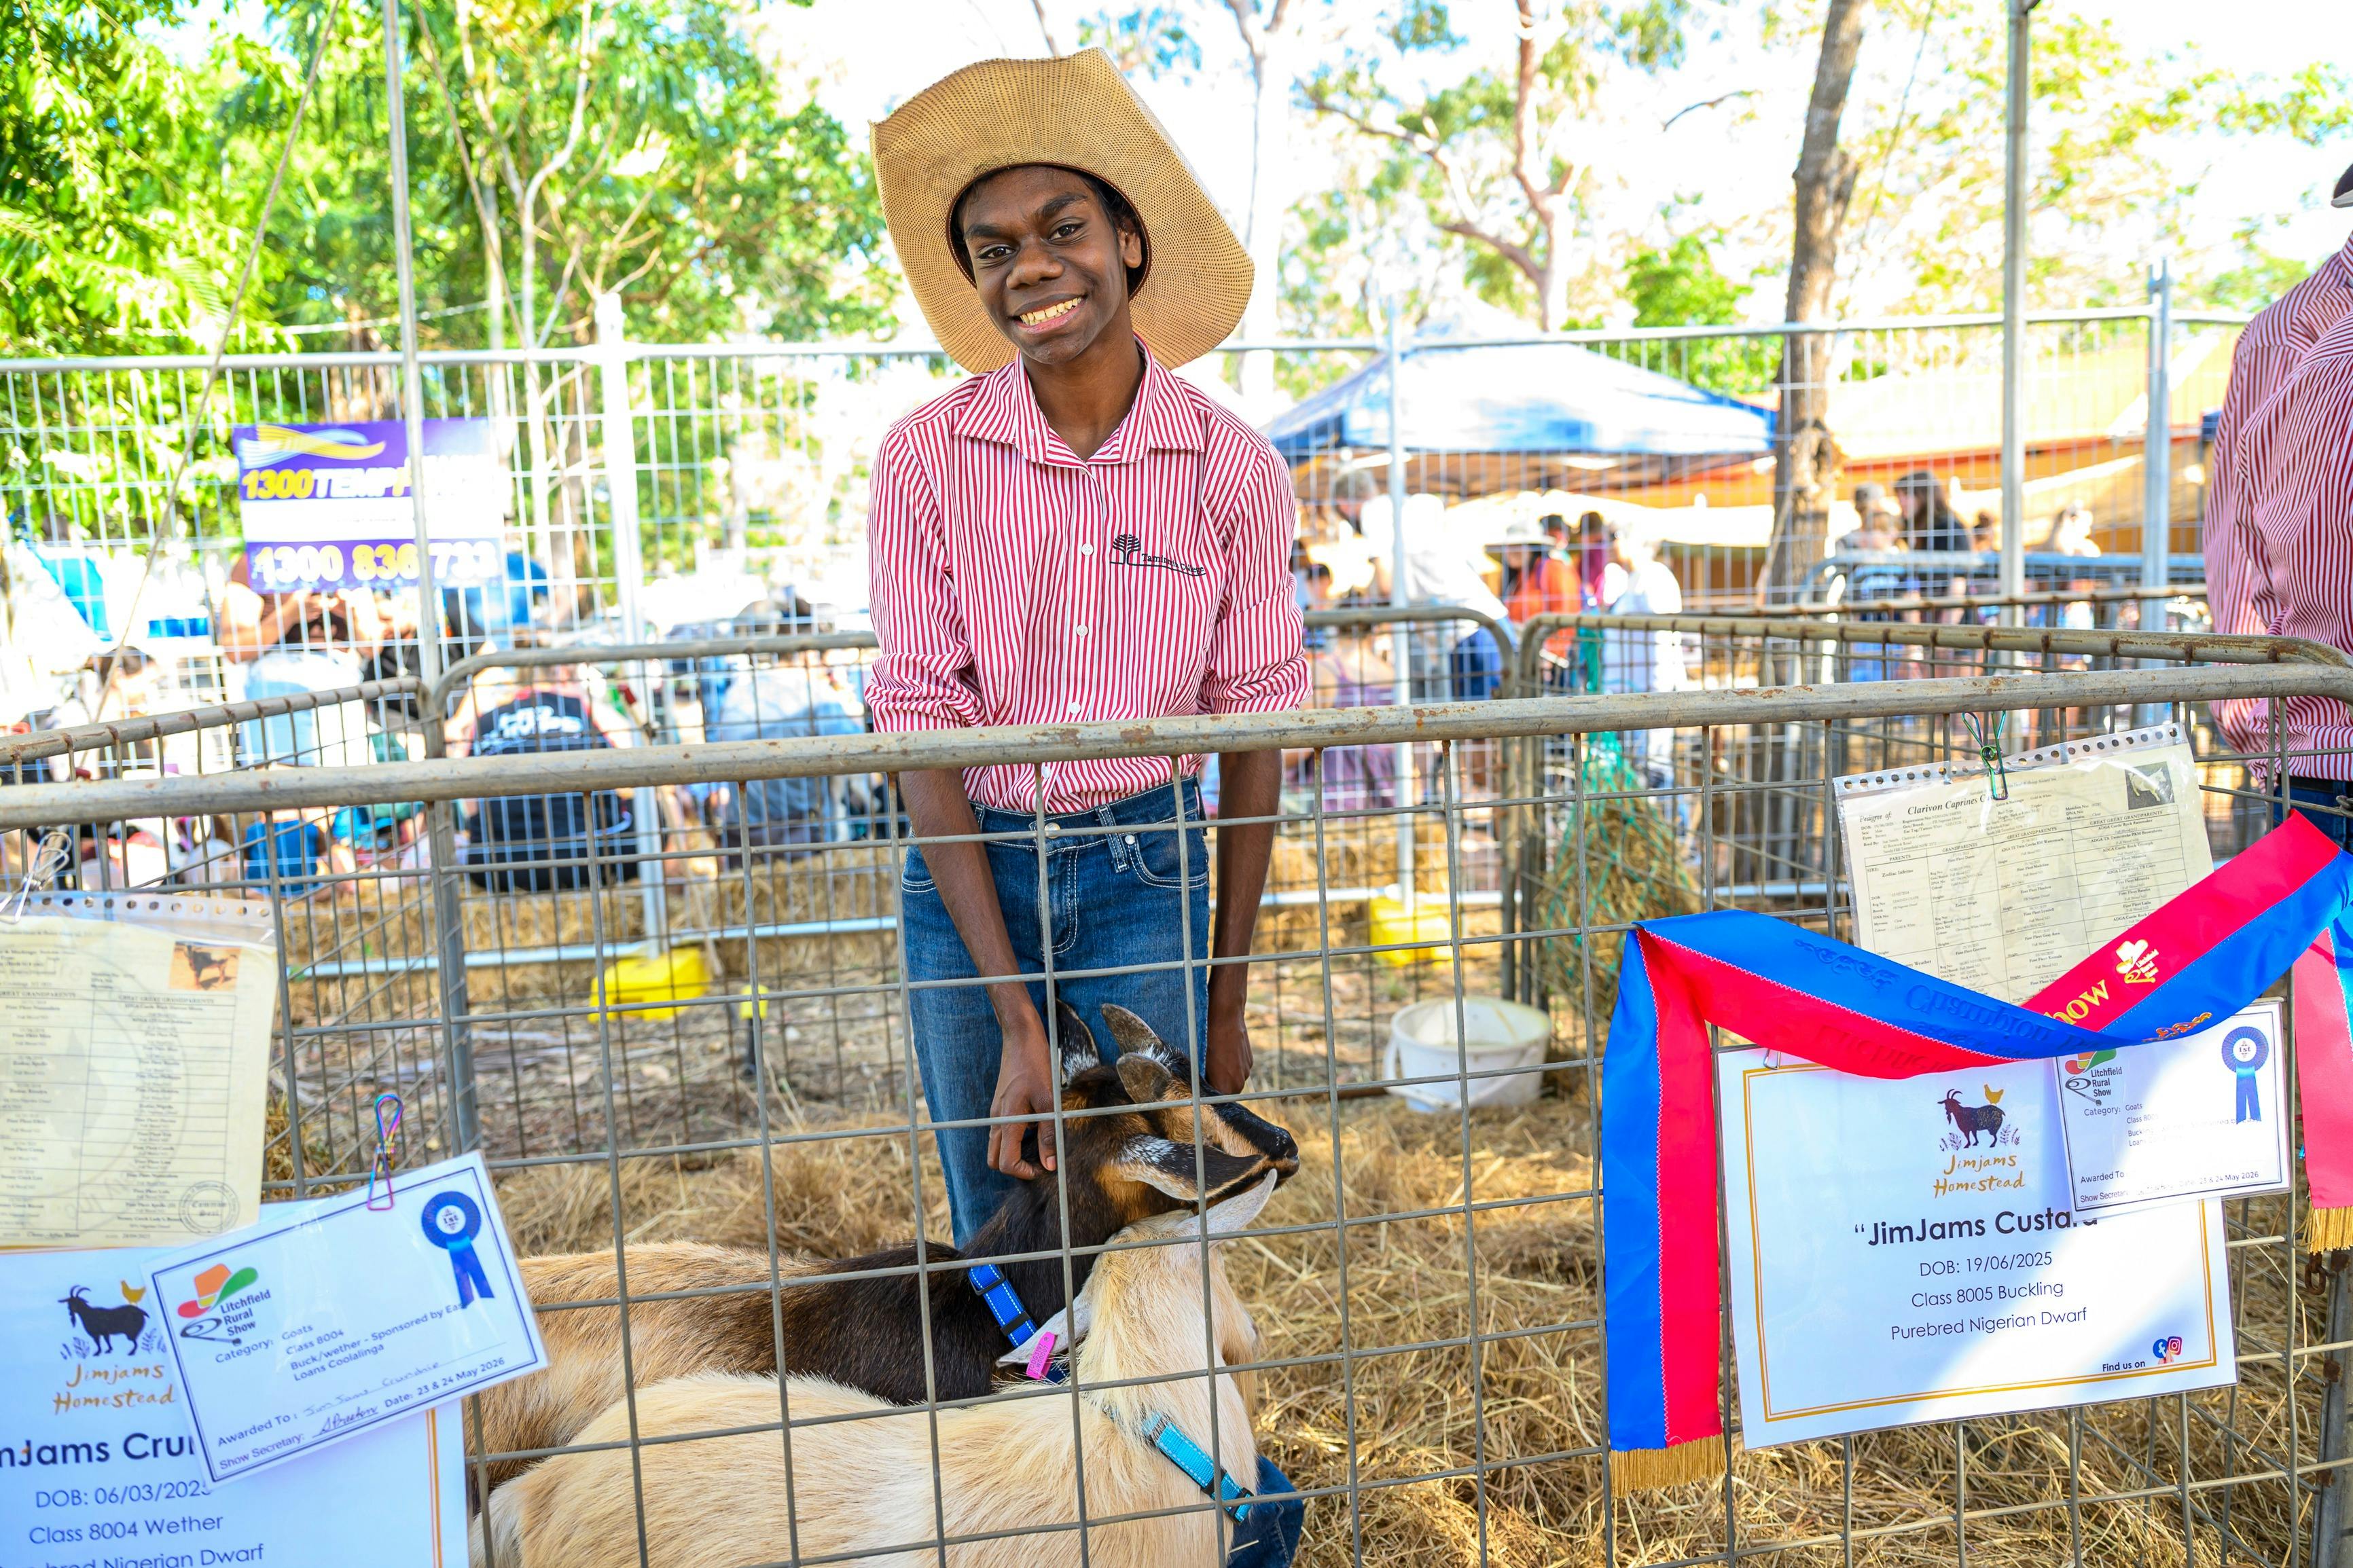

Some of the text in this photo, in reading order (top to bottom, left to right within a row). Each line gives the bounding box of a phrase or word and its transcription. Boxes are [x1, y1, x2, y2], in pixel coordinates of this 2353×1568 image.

[255, 545, 344, 584] 1300
[351, 543, 420, 581] 836
[1180, 563, 1205, 574] College
[1907, 805, 1943, 816] Clarivon
[1945, 798, 1978, 811] Caprines
[2123, 810, 2163, 820] GRANDPARENTS
[2021, 826, 2058, 837] GRANDPARENTS
[1942, 842, 1978, 853] GRANDPARENTS
[2043, 979, 2109, 1025] how
[2090, 1066, 2123, 1078] Litchfield
[2091, 1078, 2110, 1088] Rural
[2093, 1088, 2112, 1097] Show
[2083, 1102, 2143, 1117] Category: Goats
[2126, 1116, 2142, 1125] Class
[1943, 1153, 2017, 1176] Jimjams
[2080, 1171, 2114, 1184] Awarded
[1933, 1170, 2026, 1199] Homestead
[2080, 1195, 2098, 1203] Show
[2225, 1173, 2240, 1182] May
[2241, 1171, 2259, 1179] 2026
[1994, 1207, 2099, 1235] Custa
[1920, 1251, 2053, 1277] DOB: 19/06/2025
[220, 1289, 272, 1315] Litchfield
[1911, 1281, 2064, 1308] Class 8005 Buckling
[223, 1308, 254, 1325] Rural
[227, 1320, 257, 1337] Show
[1891, 1307, 2087, 1341] Purebred Nigerian Dwarf
[215, 1324, 314, 1364] Category: Goats
[286, 1329, 345, 1355] Class 8004
[290, 1338, 361, 1370] Buck/wether
[371, 1313, 429, 1343] Sponsored
[429, 1309, 445, 1320] by
[293, 1342, 385, 1382] Loans Coolalinga
[2102, 1362, 2121, 1372] Find
[2134, 1361, 2146, 1369] on
[66, 1363, 164, 1388] Jimjams
[384, 1357, 505, 1408] Date: 23 & 24 May 2026
[53, 1383, 176, 1416] Homestead
[217, 1419, 273, 1447] Awarded
[123, 1432, 195, 1461] Cru
[219, 1432, 306, 1470] Show Secretary:
[35, 1489, 89, 1509] DOB:
[29, 1515, 224, 1545] Class 8004 Wether
[200, 1543, 264, 1566] Dwarf
